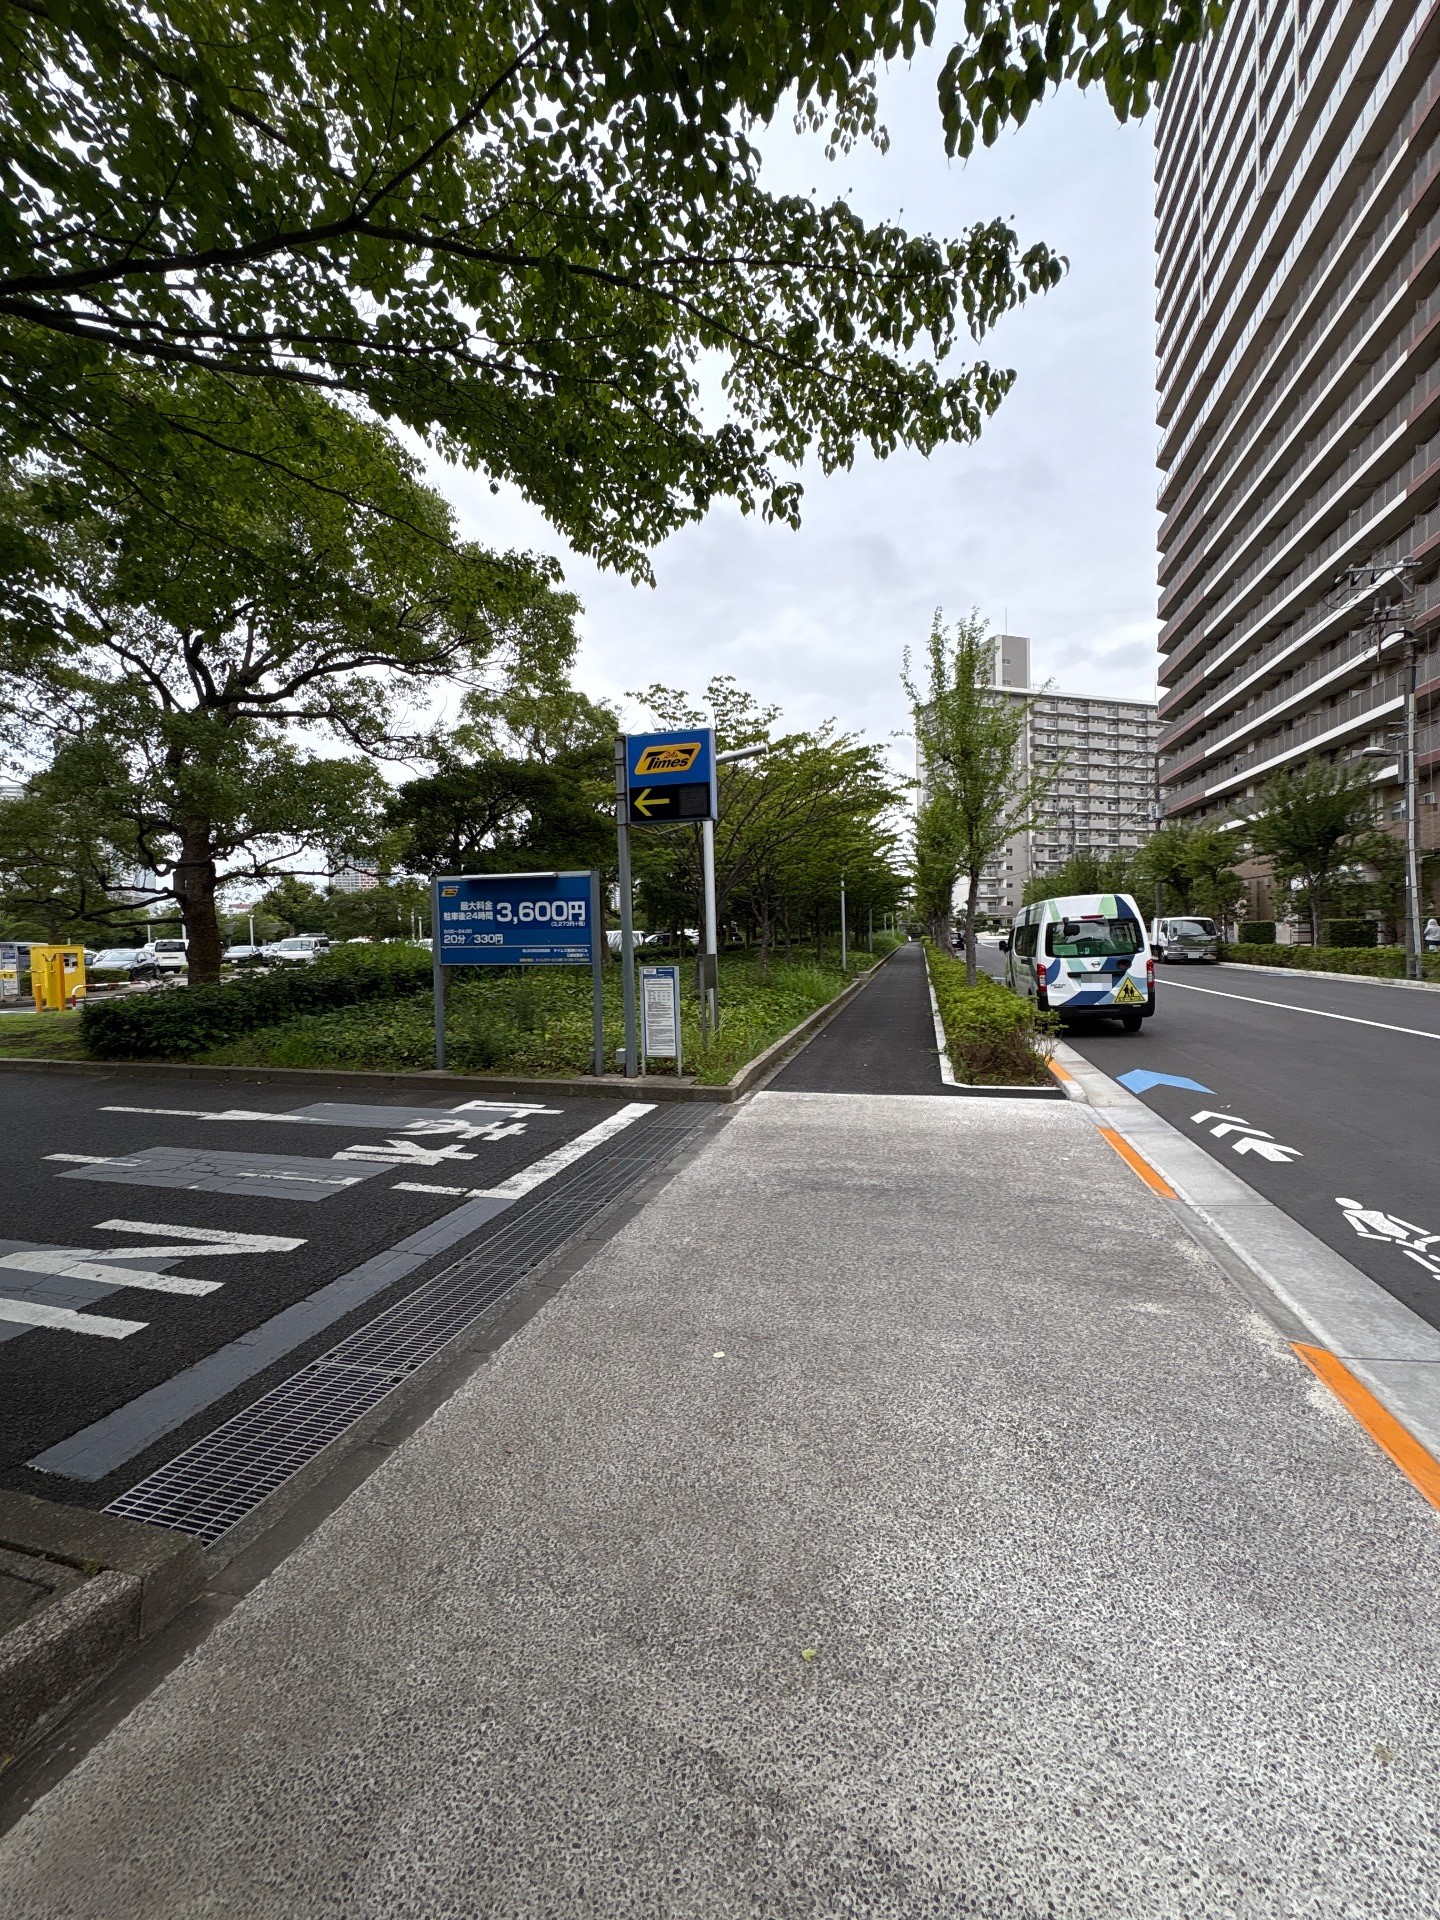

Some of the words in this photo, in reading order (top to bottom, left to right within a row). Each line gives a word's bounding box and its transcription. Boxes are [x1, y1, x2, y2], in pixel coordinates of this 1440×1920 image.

[644, 750, 694, 771] Times
[460, 901, 493, 911] 最大料金
[496, 900, 586, 925] 3,600円
[443, 911, 494, 921] 駐車後24時間
